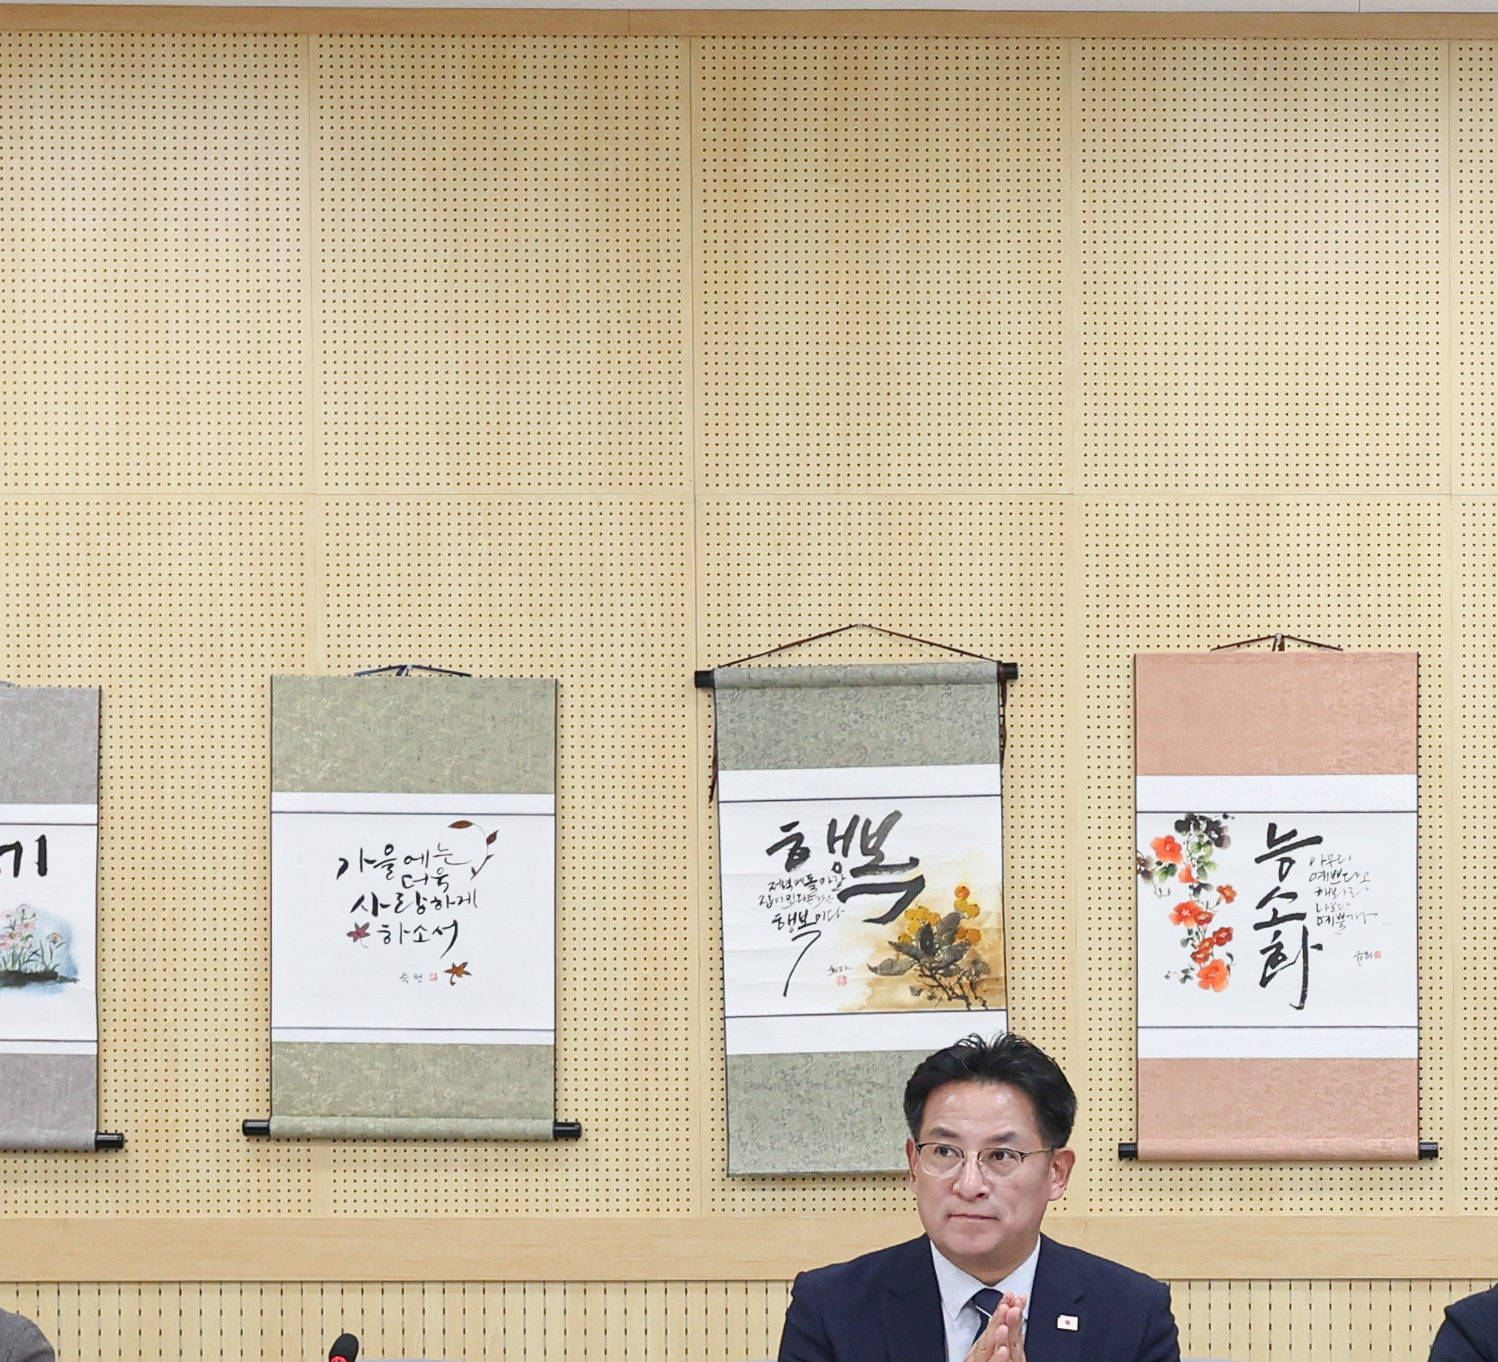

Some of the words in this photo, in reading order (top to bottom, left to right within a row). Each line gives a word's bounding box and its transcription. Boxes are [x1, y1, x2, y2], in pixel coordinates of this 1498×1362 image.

[336, 842, 472, 880] 가을에는
[401, 867, 450, 892] 더욱
[765, 810, 926, 925] 행복
[350, 889, 478, 917] 사랑하게
[1253, 822, 1324, 1010] 능소화
[377, 919, 459, 959] 하소서
